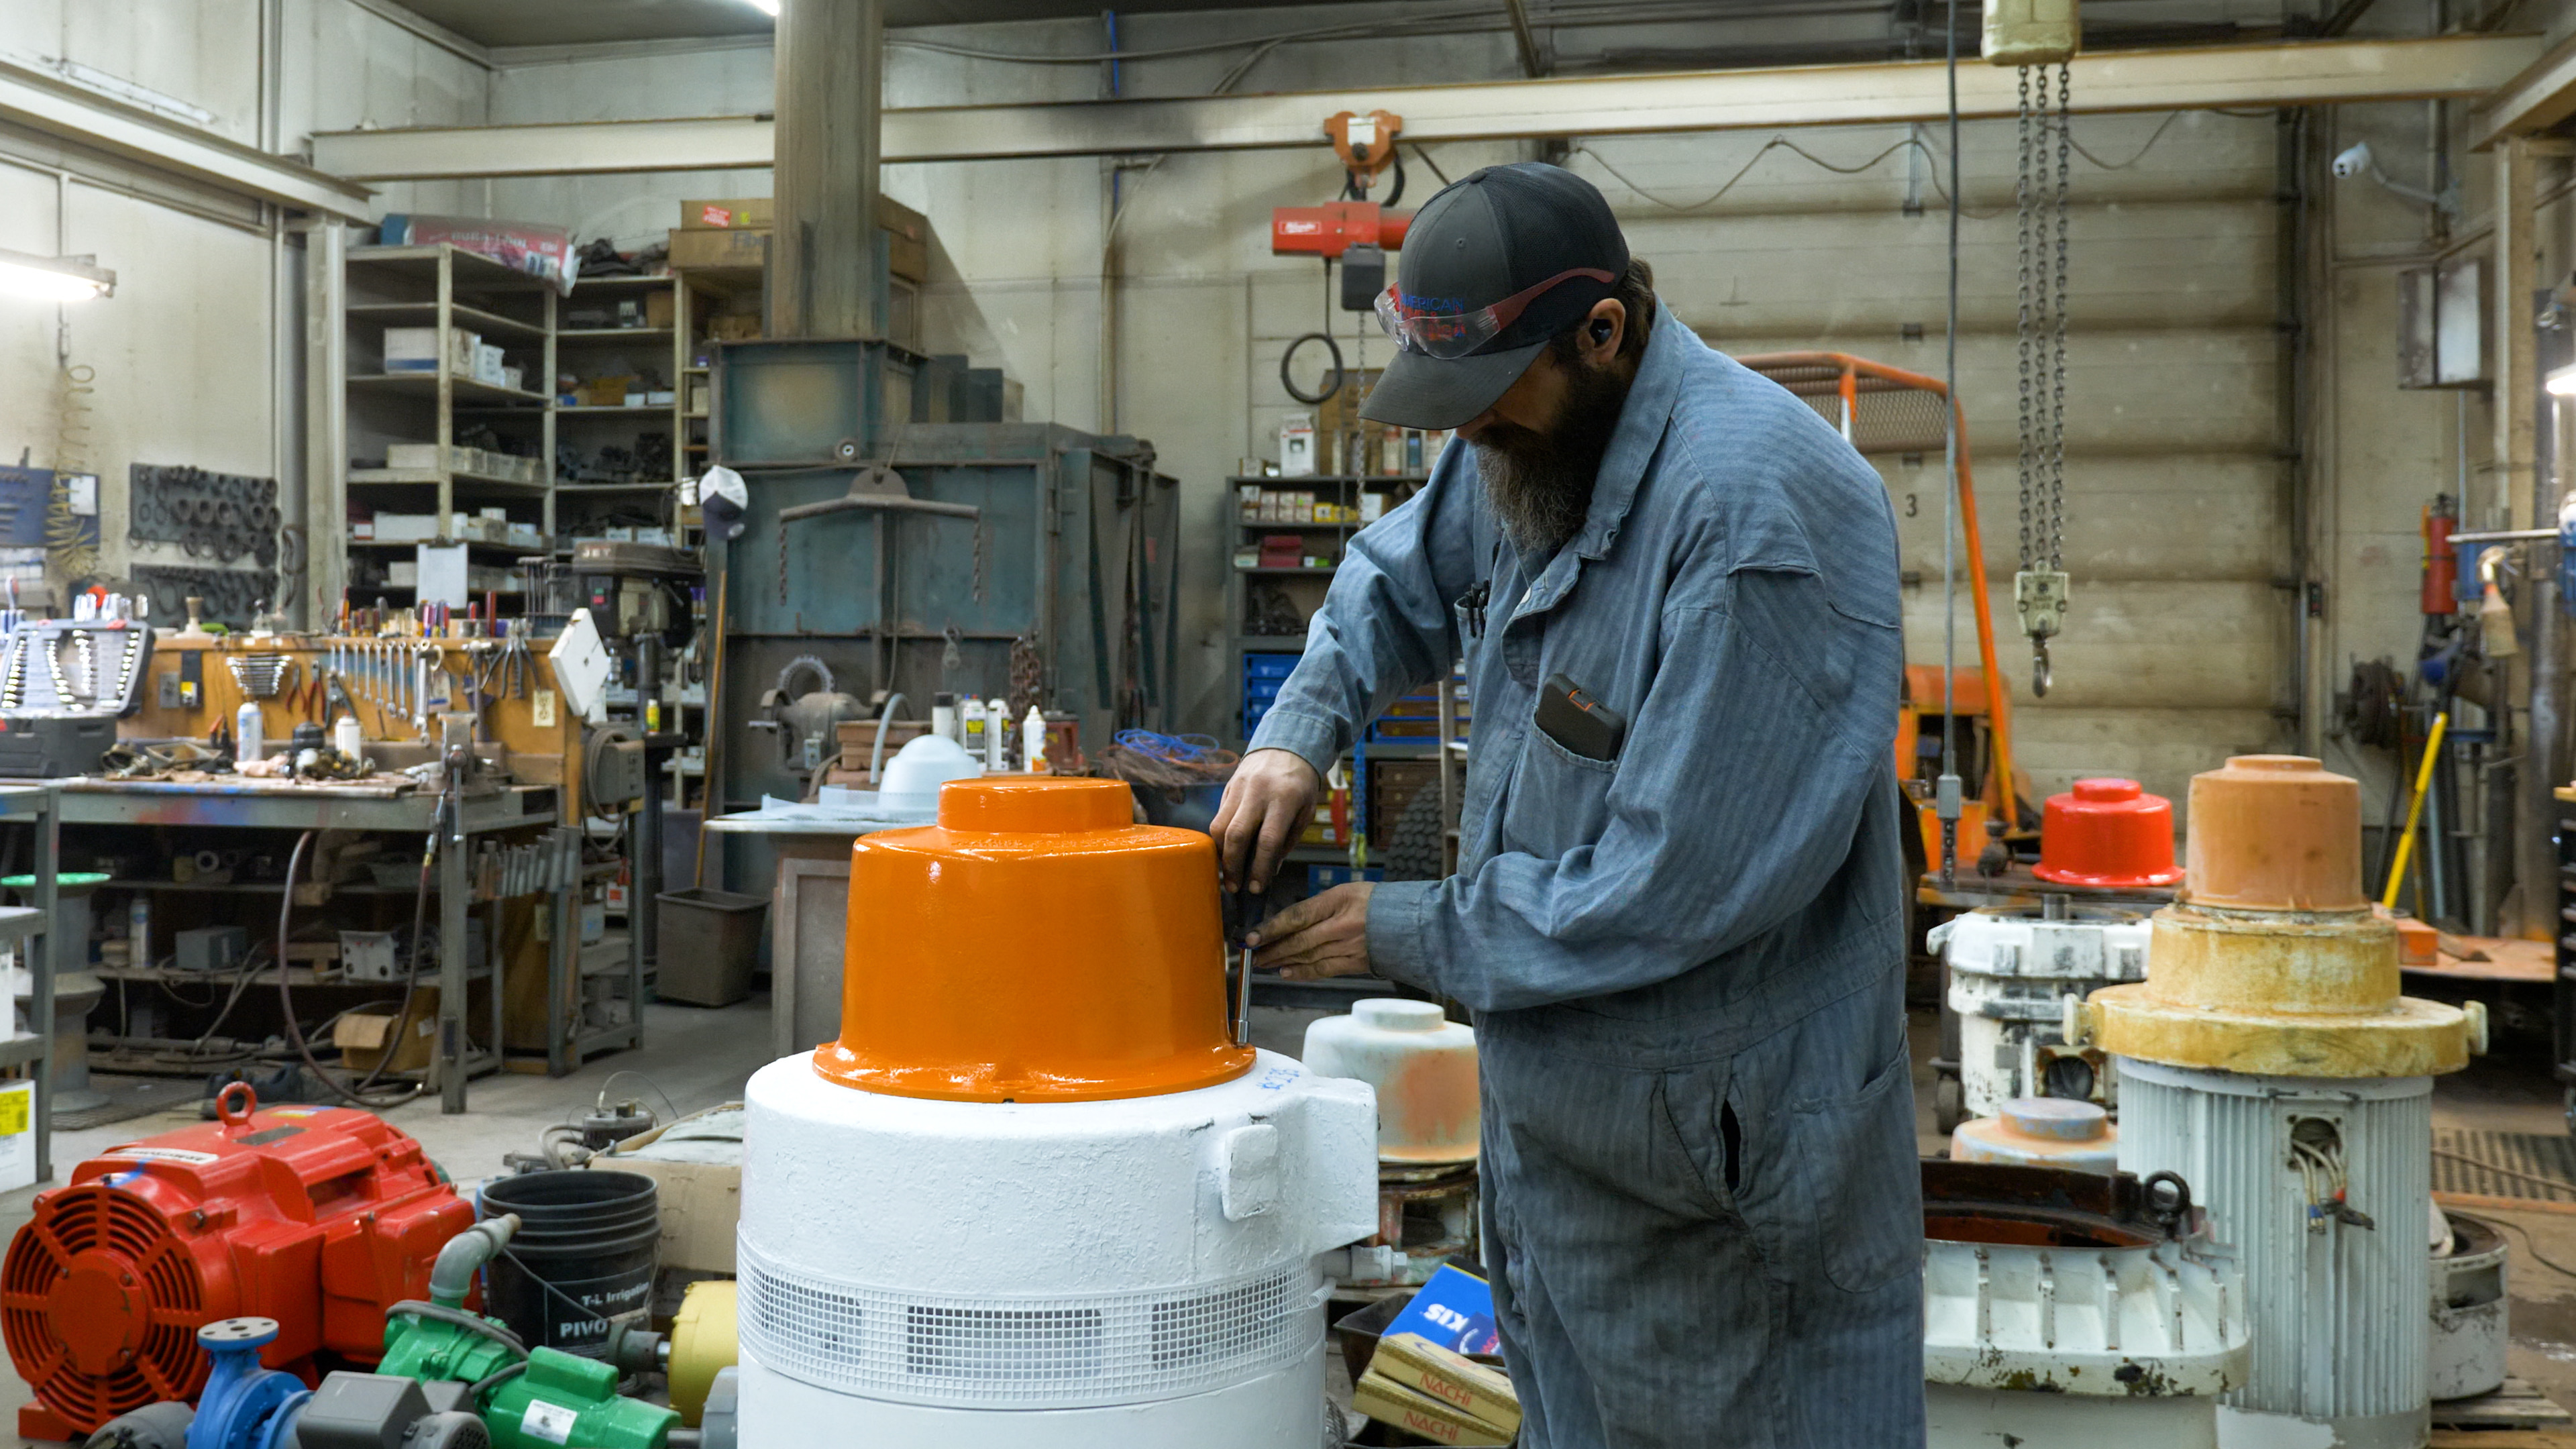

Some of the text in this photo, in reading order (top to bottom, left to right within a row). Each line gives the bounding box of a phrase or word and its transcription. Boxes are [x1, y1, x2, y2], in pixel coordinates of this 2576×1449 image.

[1905, 493, 1917, 518] 3
[582, 547, 612, 558] JET
[581, 1294, 604, 1307] T-L
[559, 1319, 608, 1338] PIVO
[1419, 1373, 1472, 1407] NACHI
[1403, 1411, 1459, 1441] NACHI
